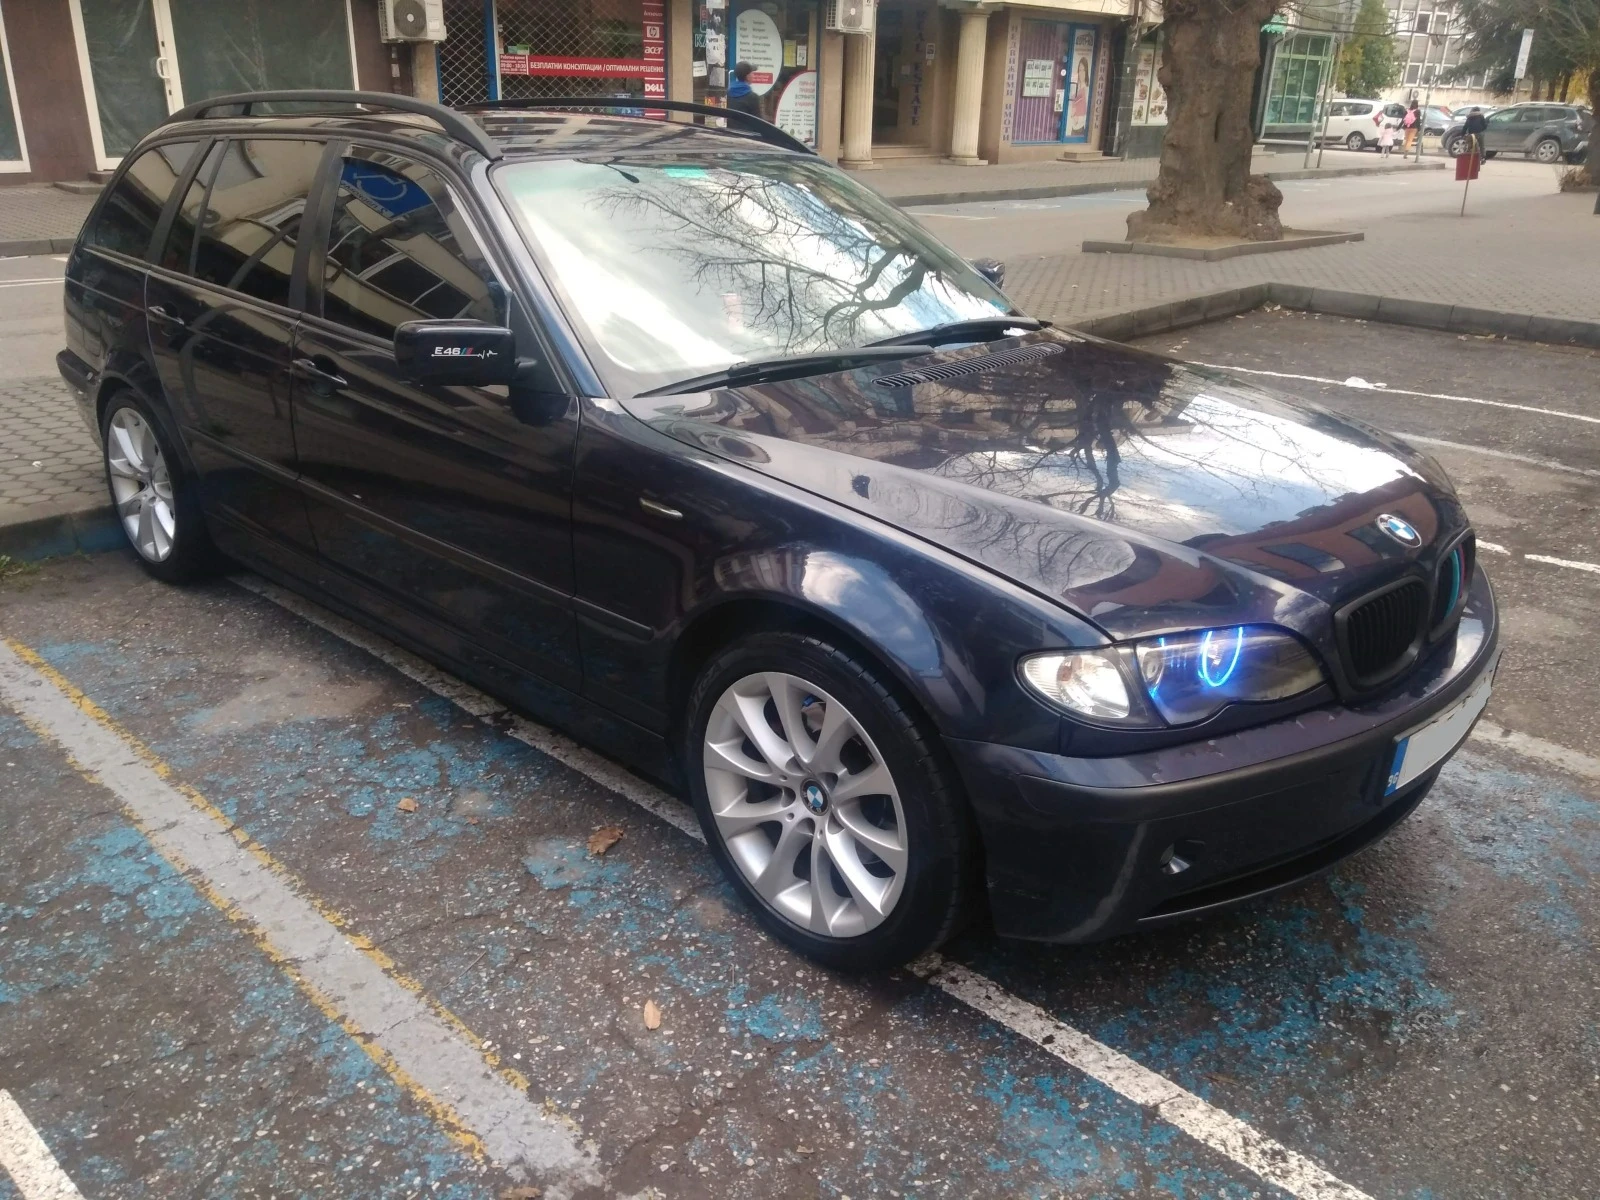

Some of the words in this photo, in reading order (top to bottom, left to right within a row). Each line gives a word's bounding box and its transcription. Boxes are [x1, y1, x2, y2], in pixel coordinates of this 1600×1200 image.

[644, 46, 664, 54] acer
[530, 61, 562, 69] БЕЗПЛАТНИ
[563, 62, 602, 71] КОНСУЛТАЦИИ
[606, 63, 639, 72] ОПТИМАЛНИ
[640, 64, 664, 73] РЕШЕНИЯ
[644, 83, 665, 92] DELL
[434, 346, 461, 355] E46
